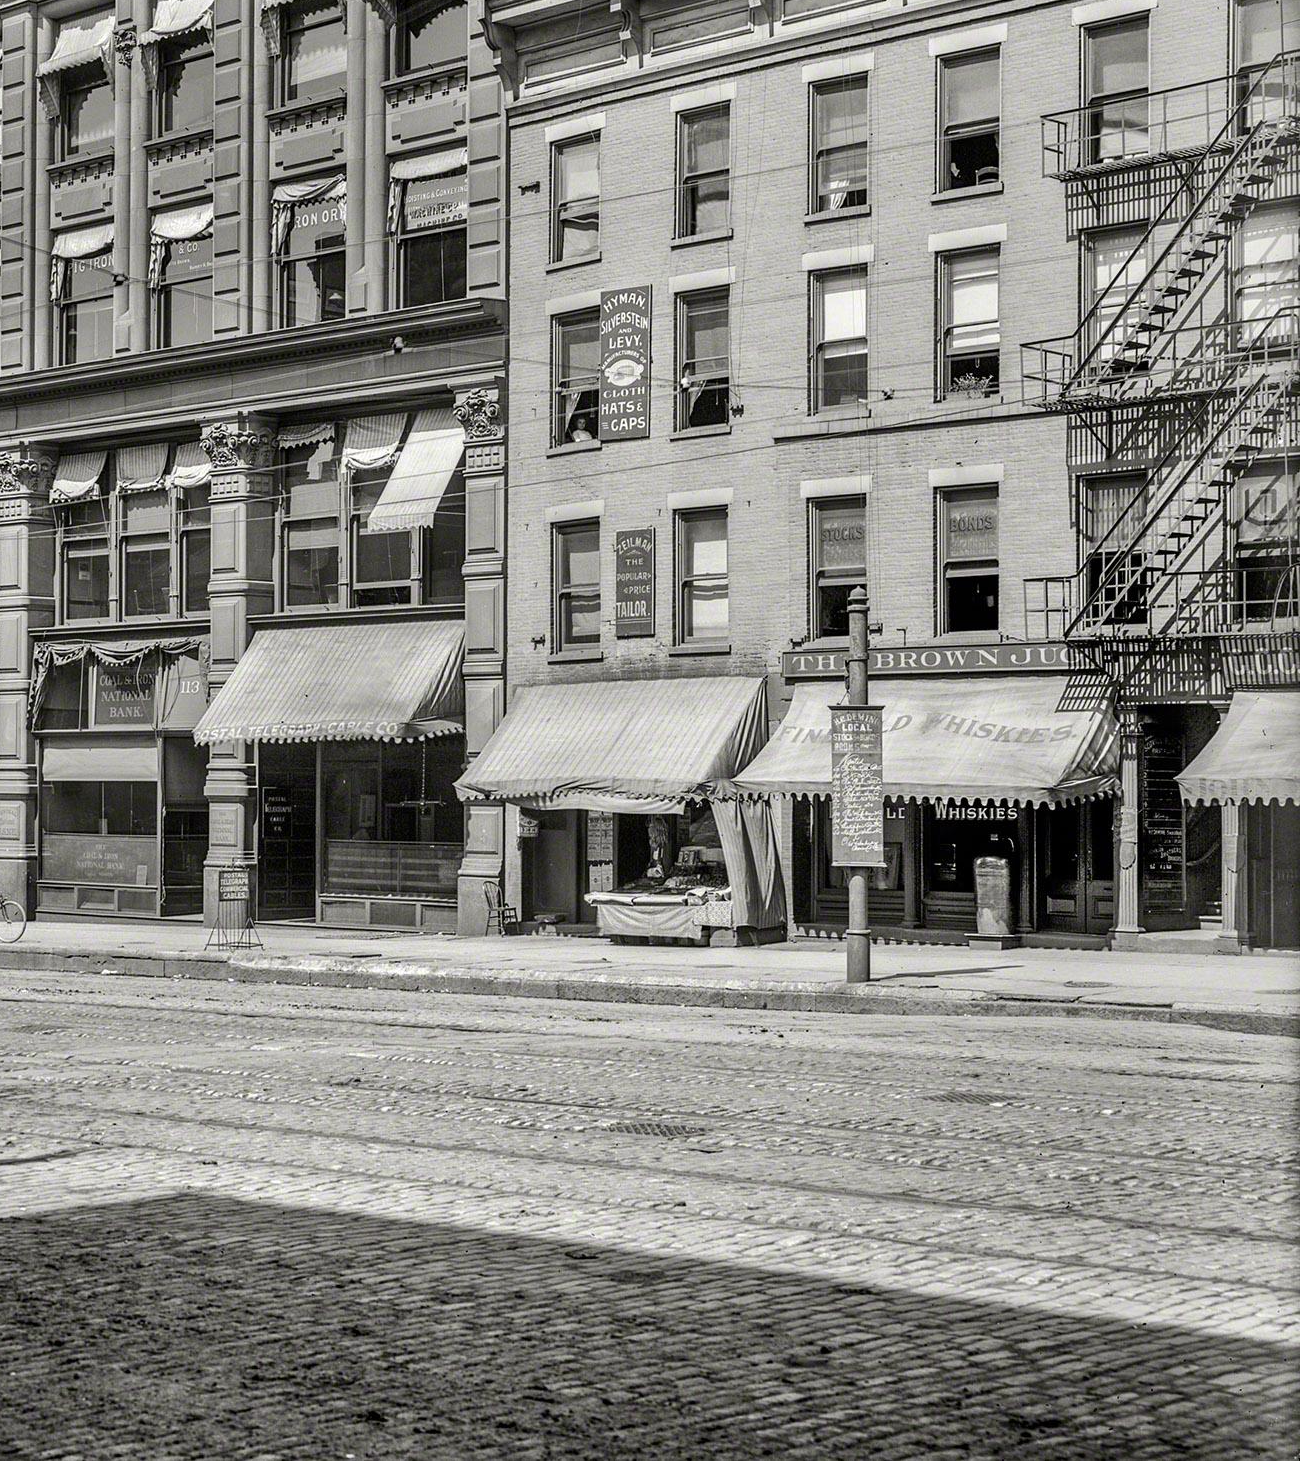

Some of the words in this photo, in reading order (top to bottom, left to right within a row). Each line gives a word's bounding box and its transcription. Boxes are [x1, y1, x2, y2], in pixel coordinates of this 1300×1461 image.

[294, 212, 318, 228] RON
[601, 312, 648, 335] SILVERSTEIN
[603, 387, 645, 398] CLOTH
[601, 401, 635, 415] HATS
[611, 417, 646, 431] CAPS
[949, 515, 993, 533] BONDS
[820, 528, 864, 542] STOCKS
[625, 558, 644, 566] THE
[628, 584, 651, 595] PRICE
[874, 648, 1000, 669] BROWN
[100, 673, 121, 687] COAL
[180, 680, 200, 694] 113
[101, 690, 151, 703] NATIONAL
[841, 723, 873, 732] LOCAL
